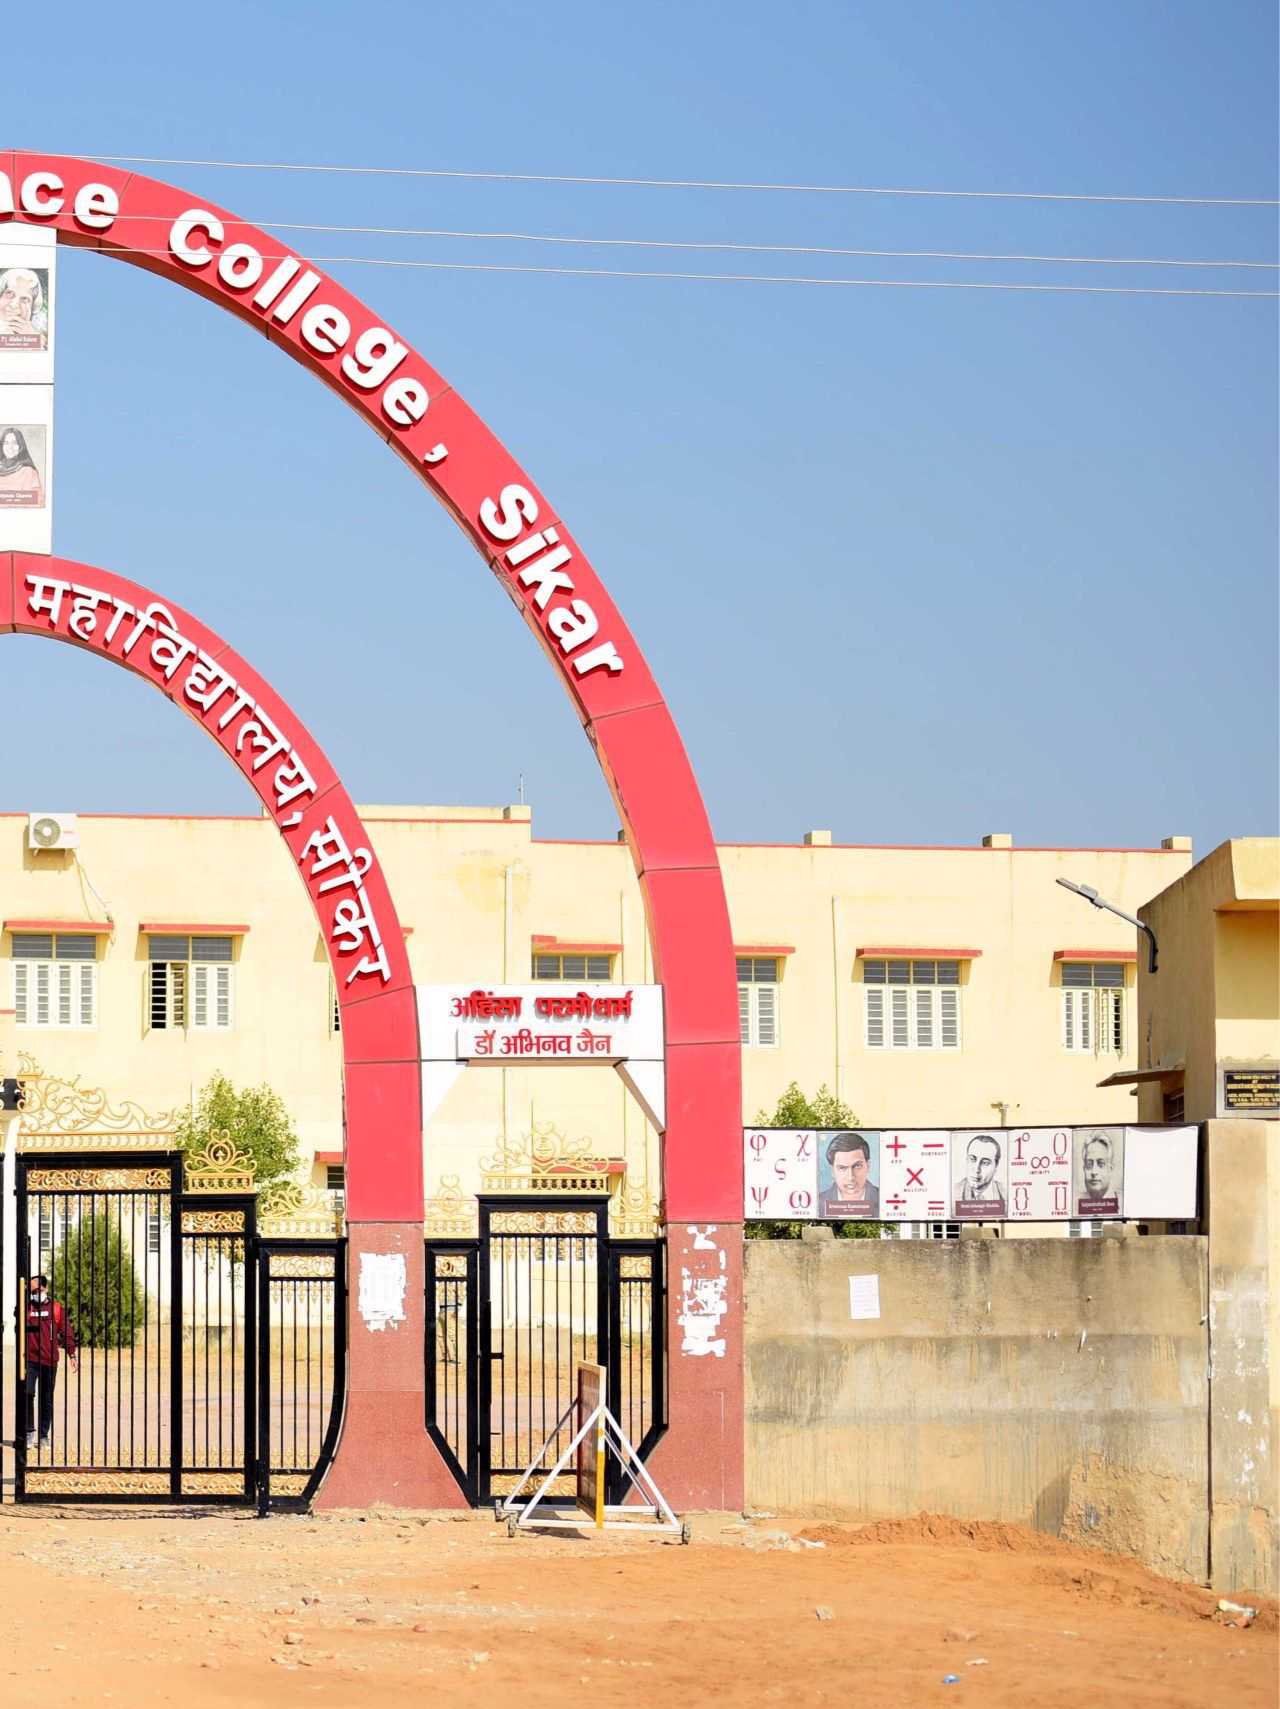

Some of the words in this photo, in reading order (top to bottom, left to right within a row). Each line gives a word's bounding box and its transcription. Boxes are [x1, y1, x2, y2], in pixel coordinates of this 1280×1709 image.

[480, 484, 623, 675] Sikar
[301, 816, 391, 983] सीकर
[450, 990, 522, 1018] अहिंसा
[474, 1029, 496, 1055] डॉ
[500, 1029, 572, 1055] अभिनव
[576, 1029, 612, 1055] जैन
